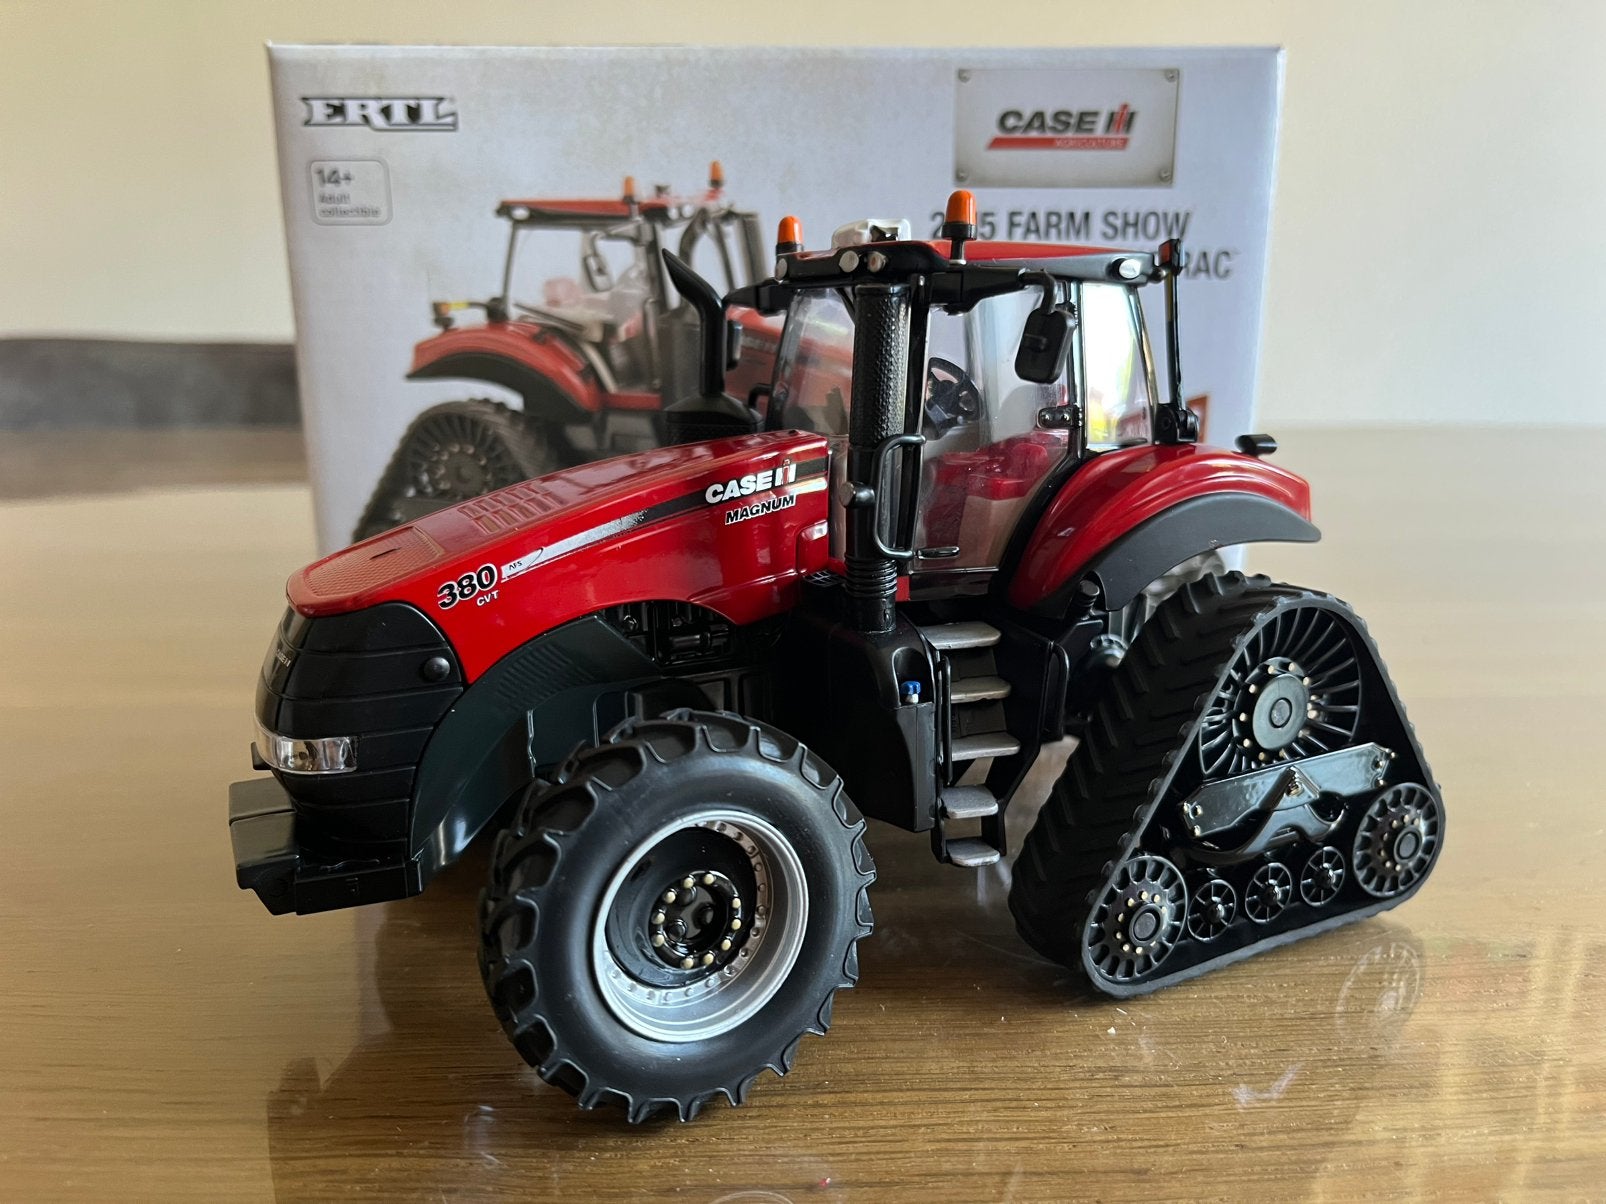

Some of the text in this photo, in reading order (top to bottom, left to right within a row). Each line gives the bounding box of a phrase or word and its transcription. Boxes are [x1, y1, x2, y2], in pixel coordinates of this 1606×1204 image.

[302, 97, 457, 131] ERTL
[998, 110, 1100, 134] CASE
[316, 168, 353, 187] 14+
[931, 210, 1191, 240] 25 FARM SHOW
[705, 469, 773, 504] CASE
[725, 494, 796, 525] MAGNUM
[508, 560, 523, 571] AFS
[437, 563, 498, 609] 380
[476, 590, 500, 606] CVT
